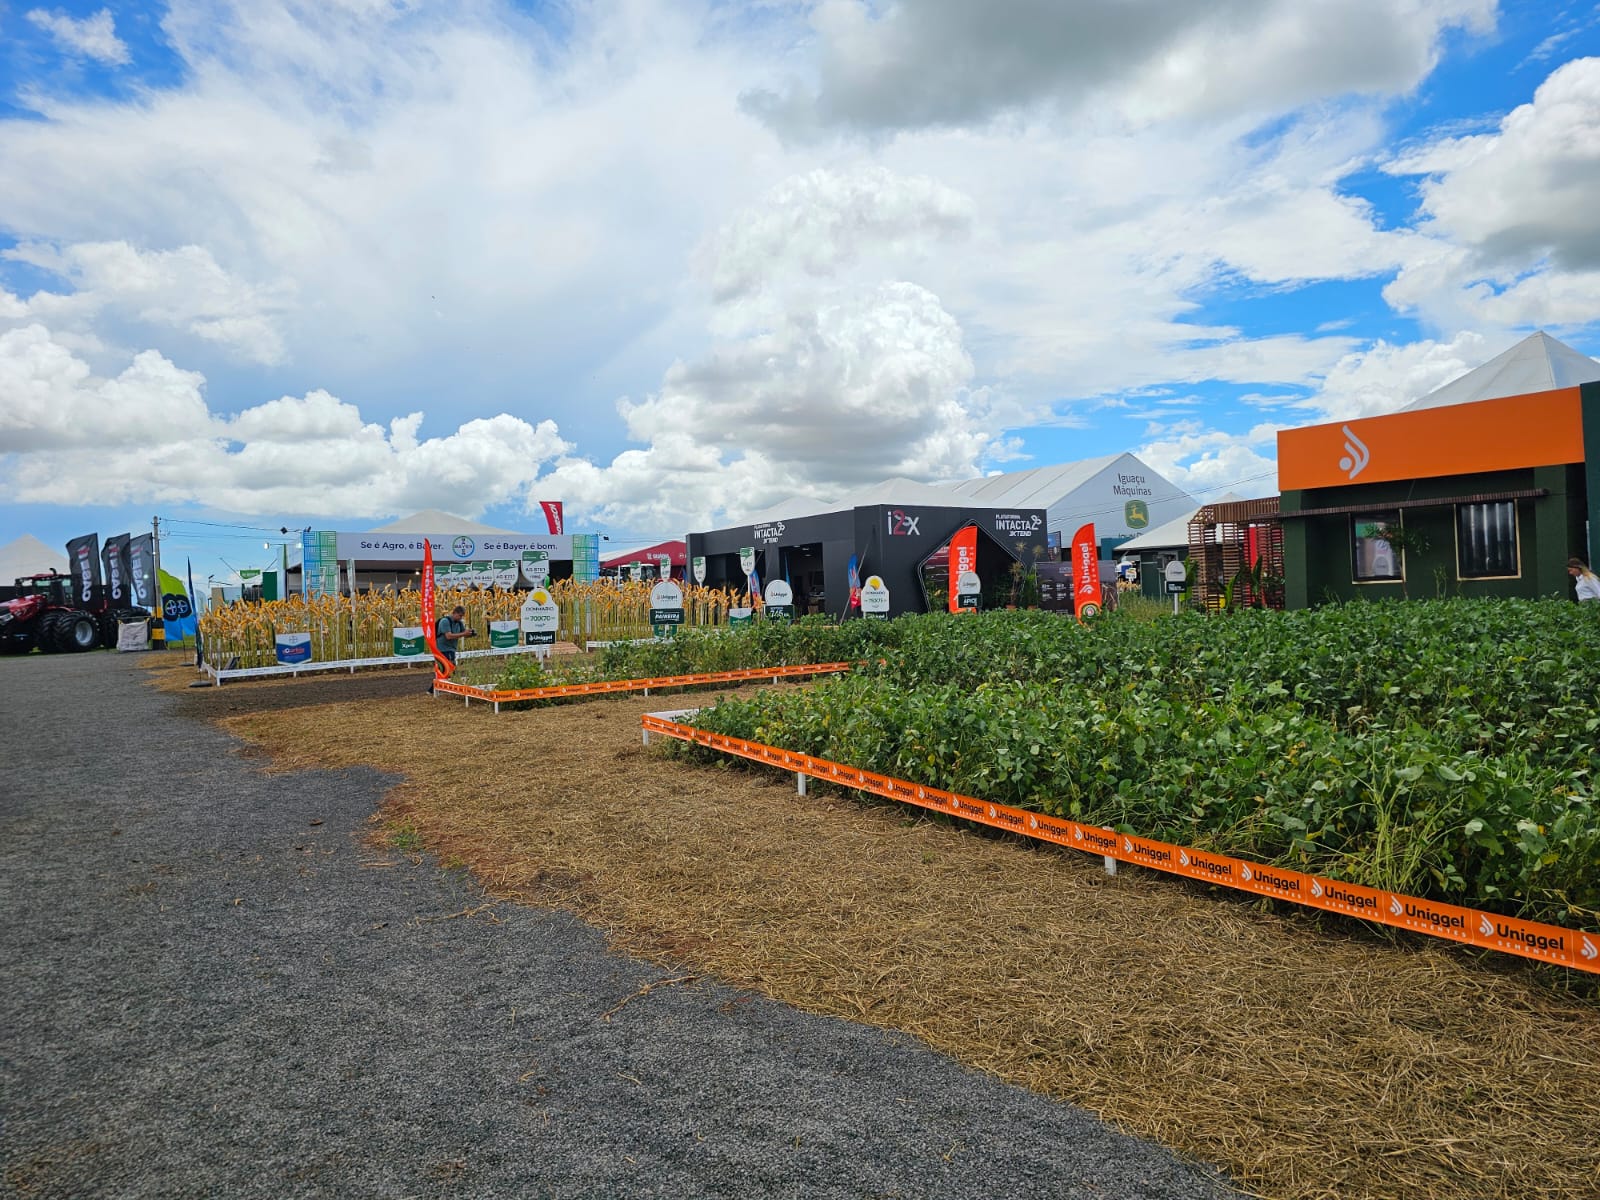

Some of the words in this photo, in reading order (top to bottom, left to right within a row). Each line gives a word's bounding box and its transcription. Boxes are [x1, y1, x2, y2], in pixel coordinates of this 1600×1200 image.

[1117, 472, 1145, 485] Iguaçu
[1113, 485, 1152, 497] Máquinas
[360, 541, 372, 549] Se
[382, 541, 407, 551] Agro,
[484, 542, 495, 550] Se
[503, 542, 529, 552] Bayer,
[537, 542, 558, 550] bom.
[893, 782, 915, 796] Uniggel
[924, 790, 948, 804] Uniggel
[959, 800, 985, 815] Uniggel
[996, 809, 1025, 826] Uniggel
[1038, 819, 1068, 836] Uniggel
[1083, 831, 1117, 848] Uniggel
[1133, 843, 1171, 860] Uniggel
[1190, 856, 1232, 875] Uniggel
[1253, 869, 1300, 891] Uniggel
[1324, 885, 1377, 908] Uniggel
[1325, 901, 1379, 917] SEMENTES
[1405, 904, 1465, 928] Uniggel
[1406, 919, 1467, 938] SEMENTES
[1496, 924, 1564, 950] Uniggel
[1498, 940, 1566, 960] SEMENTES
